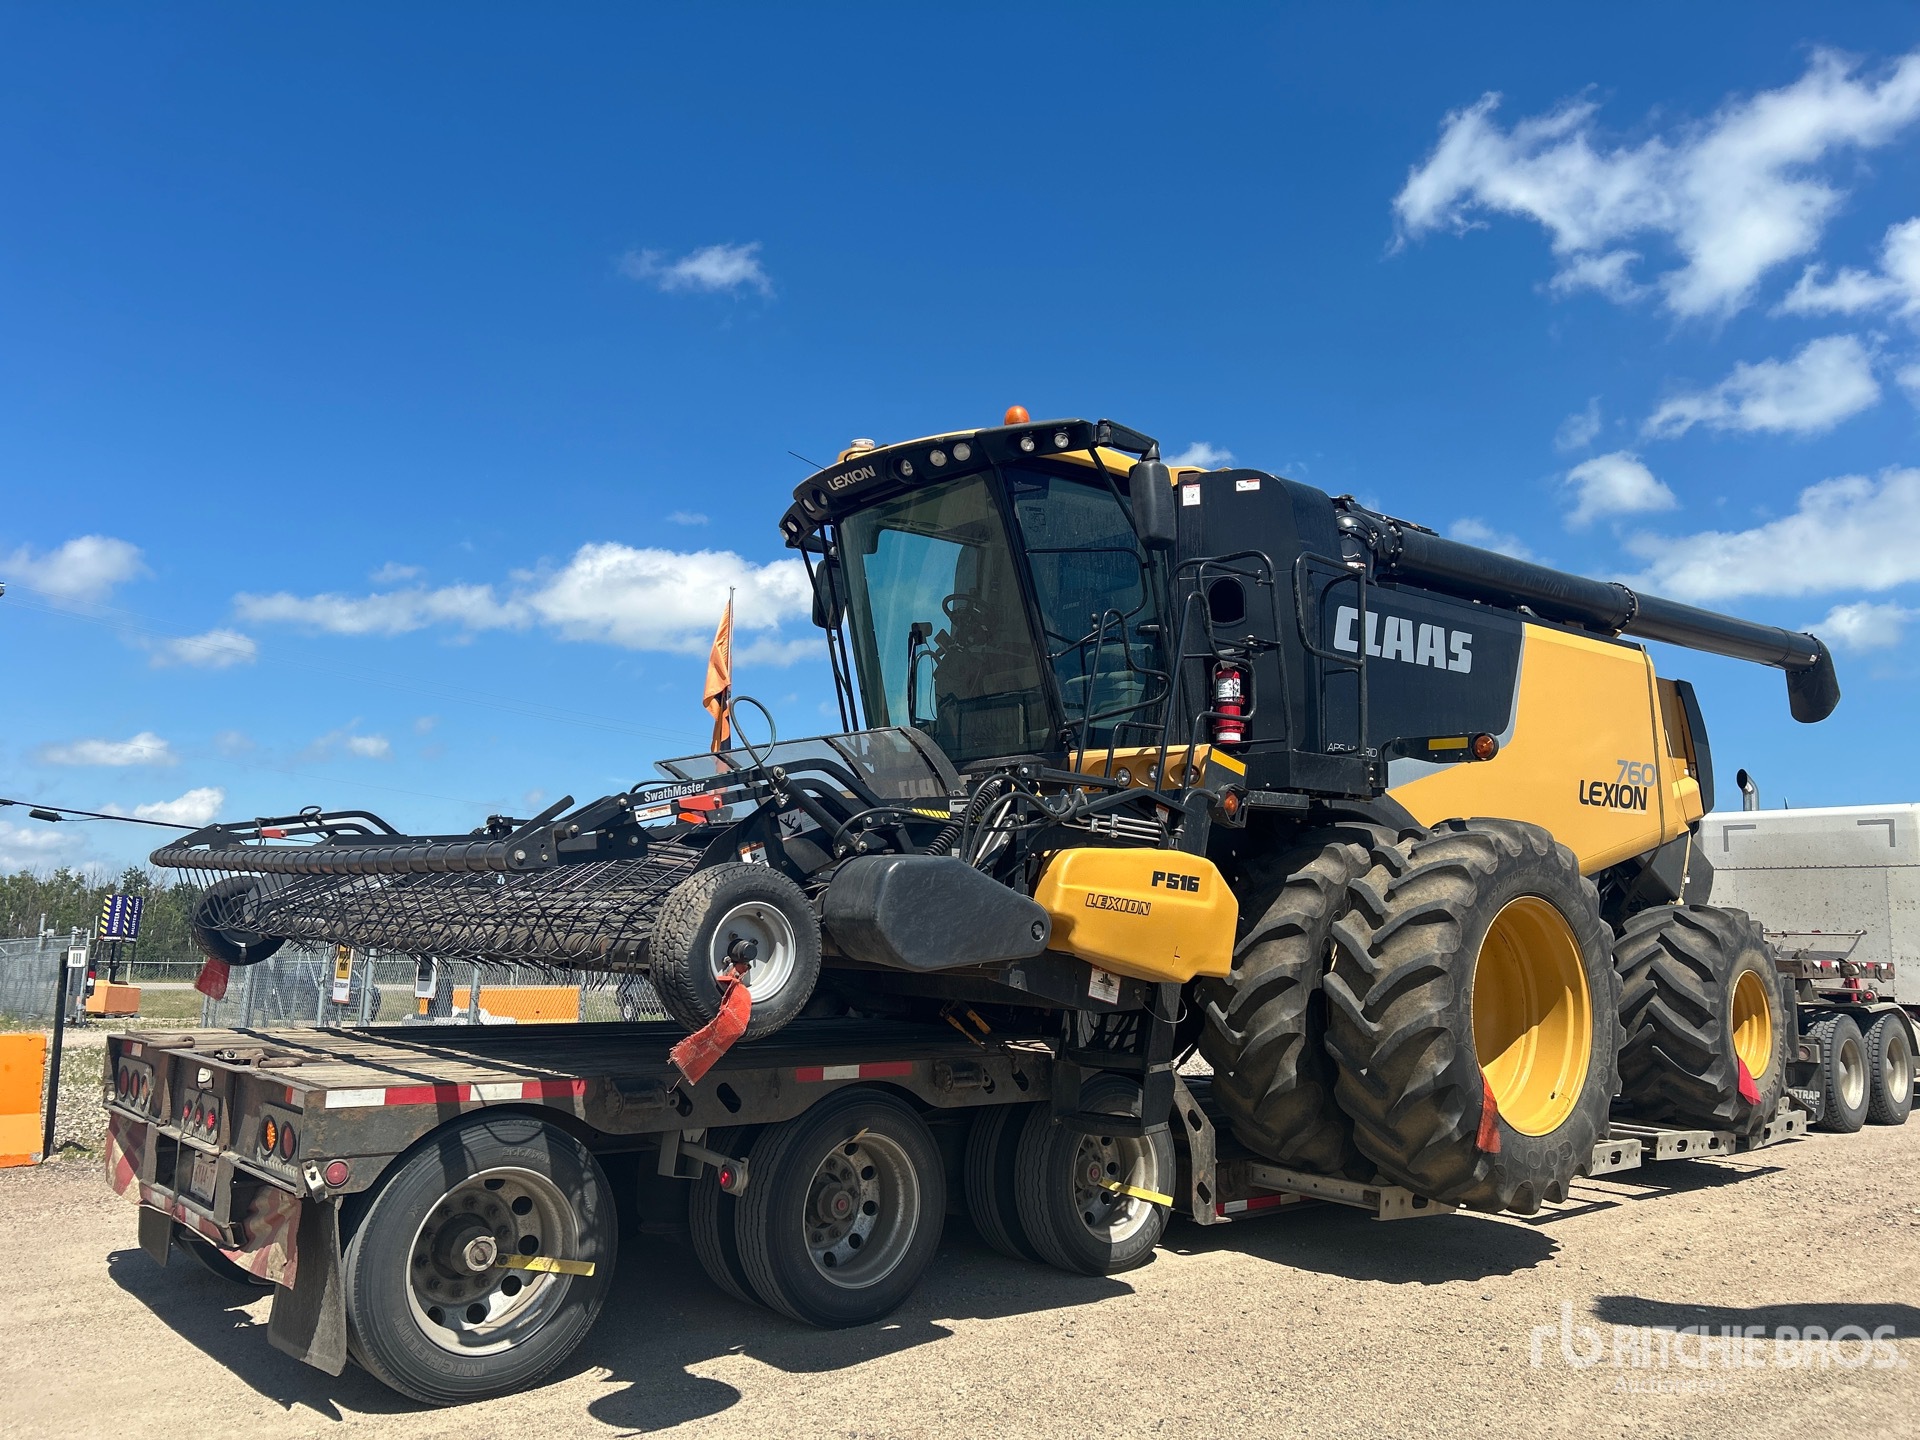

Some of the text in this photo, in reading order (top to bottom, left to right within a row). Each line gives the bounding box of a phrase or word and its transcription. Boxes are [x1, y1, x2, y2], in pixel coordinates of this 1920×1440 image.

[827, 465, 876, 491] LEXION
[1333, 605, 1473, 674] CLAAS
[1616, 759, 1656, 788] 760
[644, 782, 705, 803] SwathMaster
[1579, 779, 1647, 811] LEXION
[1151, 870, 1200, 892] P516
[1085, 893, 1151, 915] LEXION
[393, 1315, 486, 1378] MICHELIN
